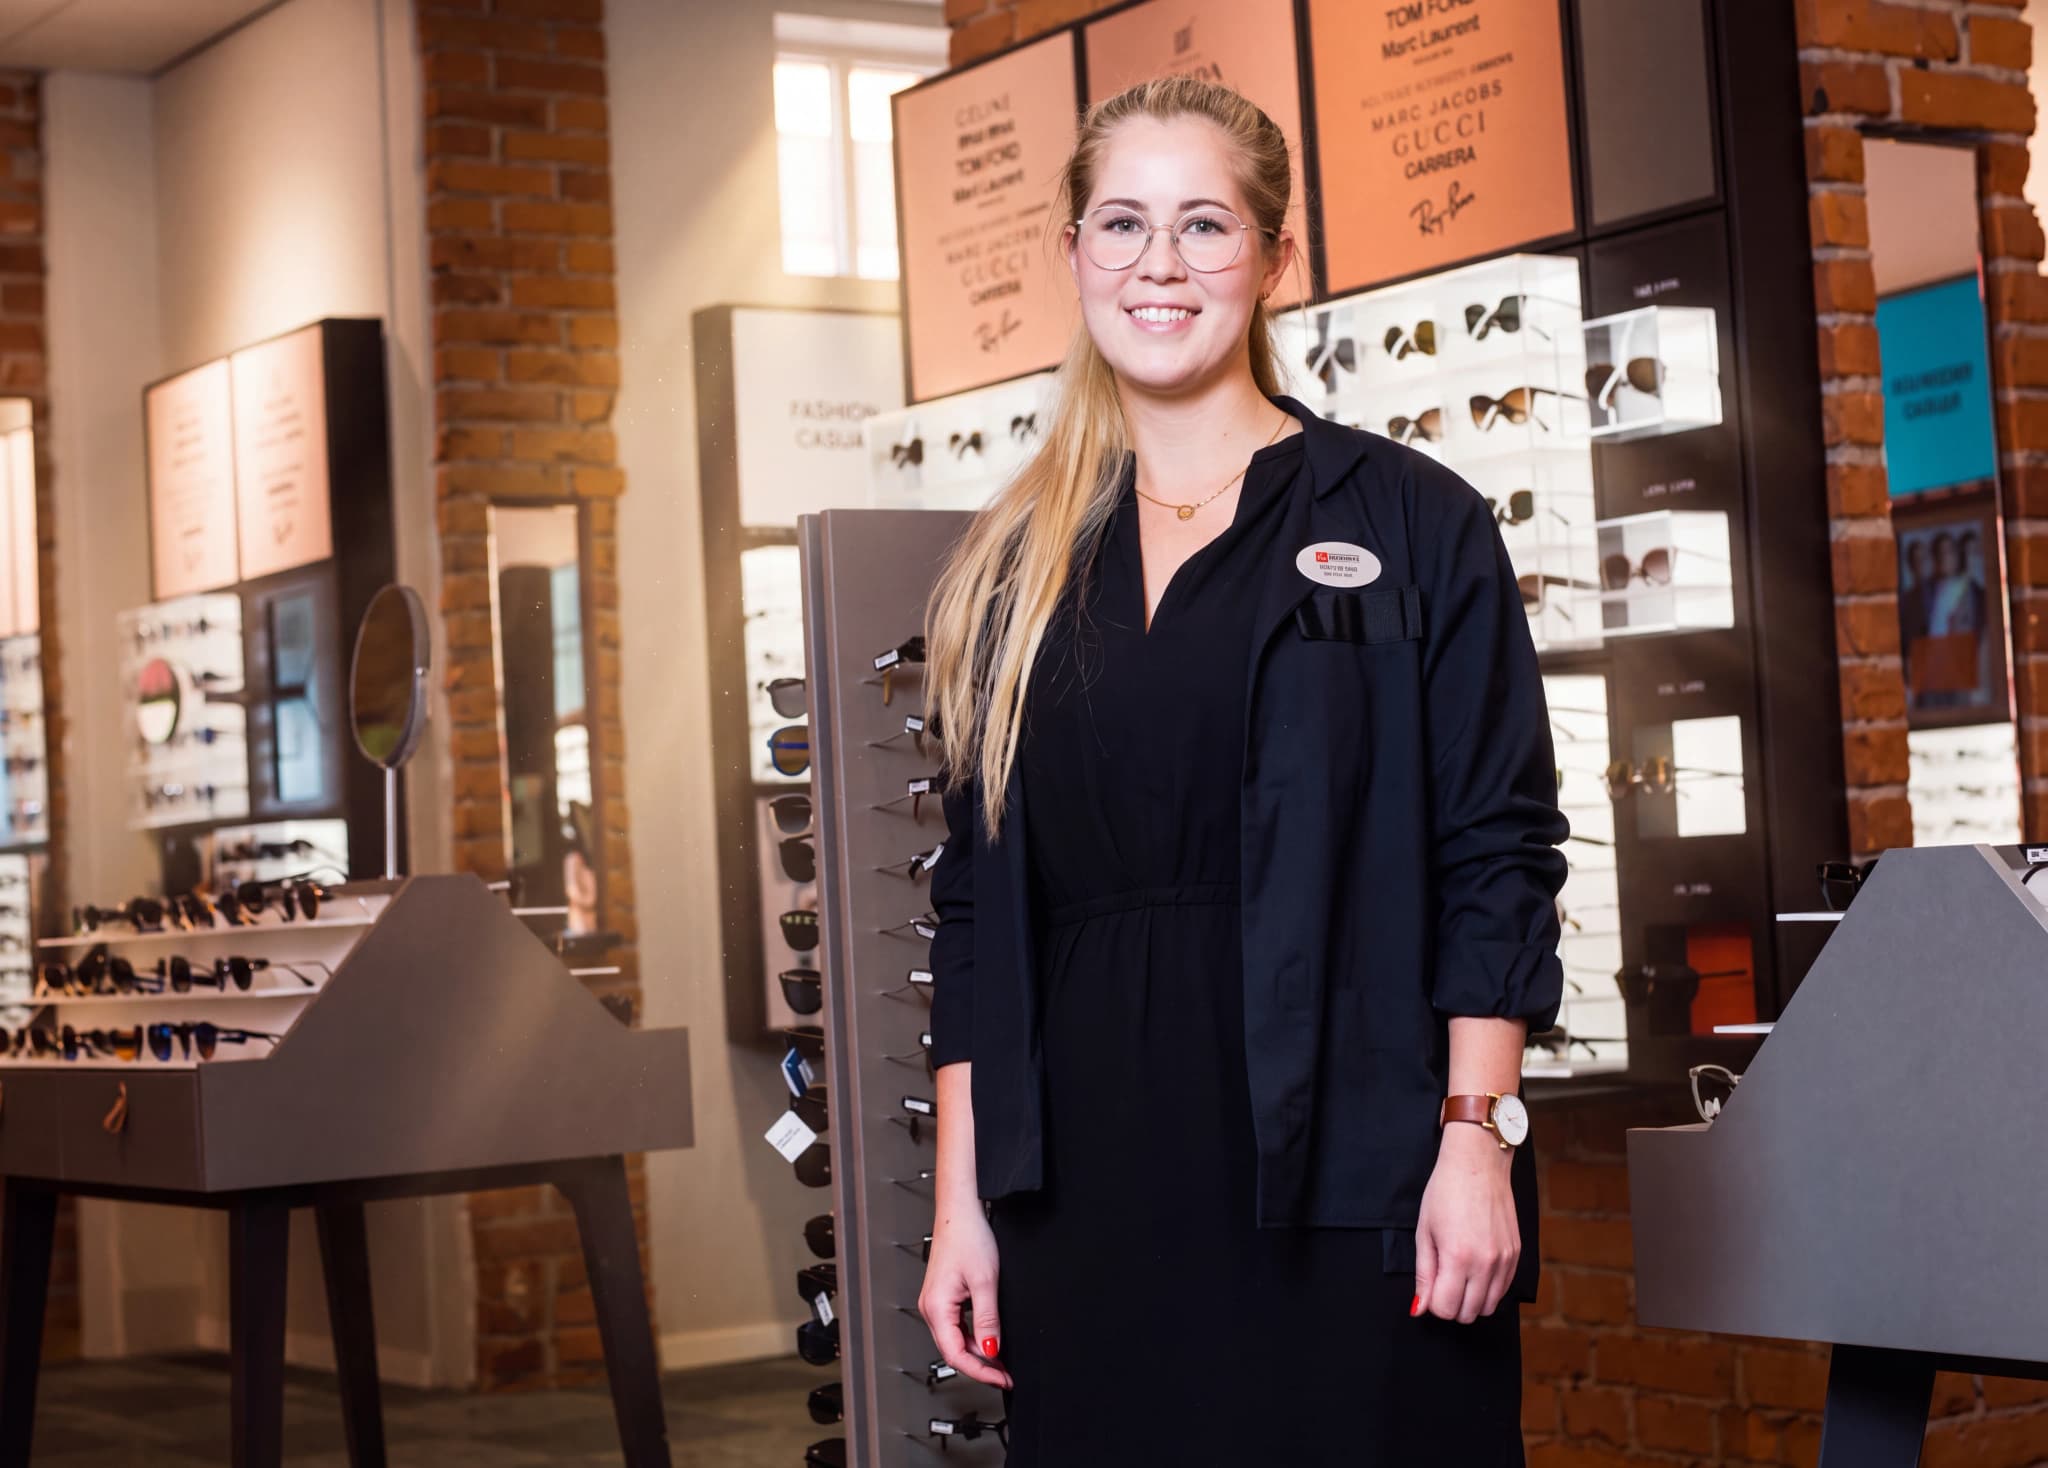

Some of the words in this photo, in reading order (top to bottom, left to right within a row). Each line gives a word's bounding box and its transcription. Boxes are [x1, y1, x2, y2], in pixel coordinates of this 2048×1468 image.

[1385, 1, 1423, 31] TOM
[1426, 0, 1475, 16] FO
[1381, 36, 1417, 60] Marc
[1419, 13, 1480, 48] Laurent
[1371, 104, 1421, 133] MARC
[1430, 79, 1503, 117] JACOBS
[1391, 110, 1486, 157] GUCCI
[1404, 146, 1477, 180] CARRERA
[795, 428, 864, 449] CASUA
